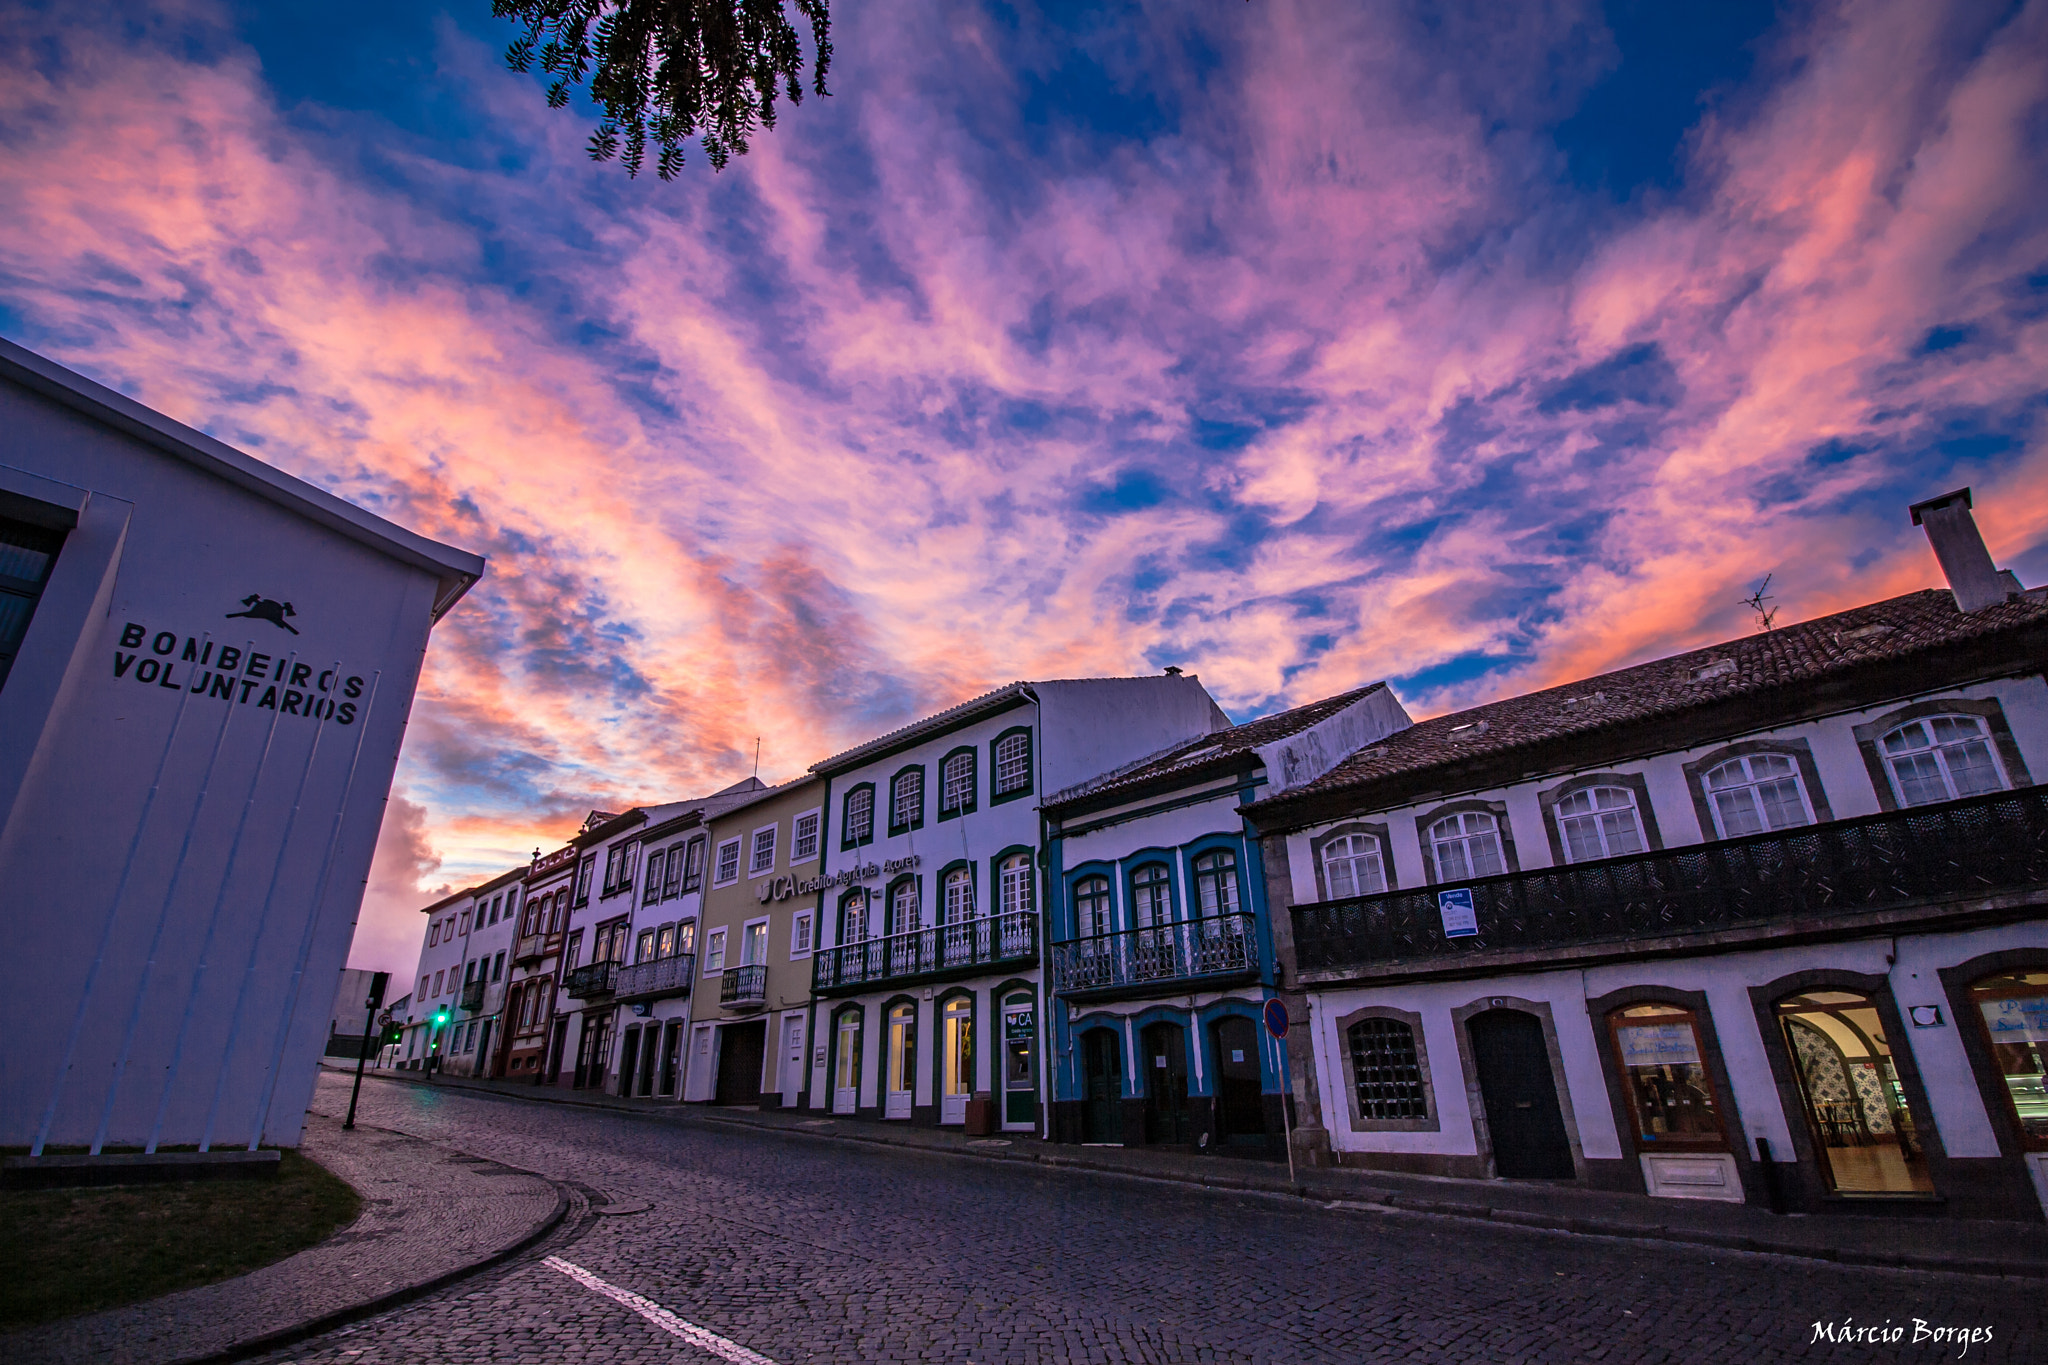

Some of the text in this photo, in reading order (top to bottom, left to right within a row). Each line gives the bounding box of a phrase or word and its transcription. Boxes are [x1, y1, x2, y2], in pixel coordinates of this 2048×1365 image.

[113, 651, 358, 725] VOLUNTARIOS
[119, 622, 365, 698] BOMBEIROS
[773, 855, 919, 901] CA Crédito Agrícola Açores
[1018, 1012, 1033, 1026] CA
